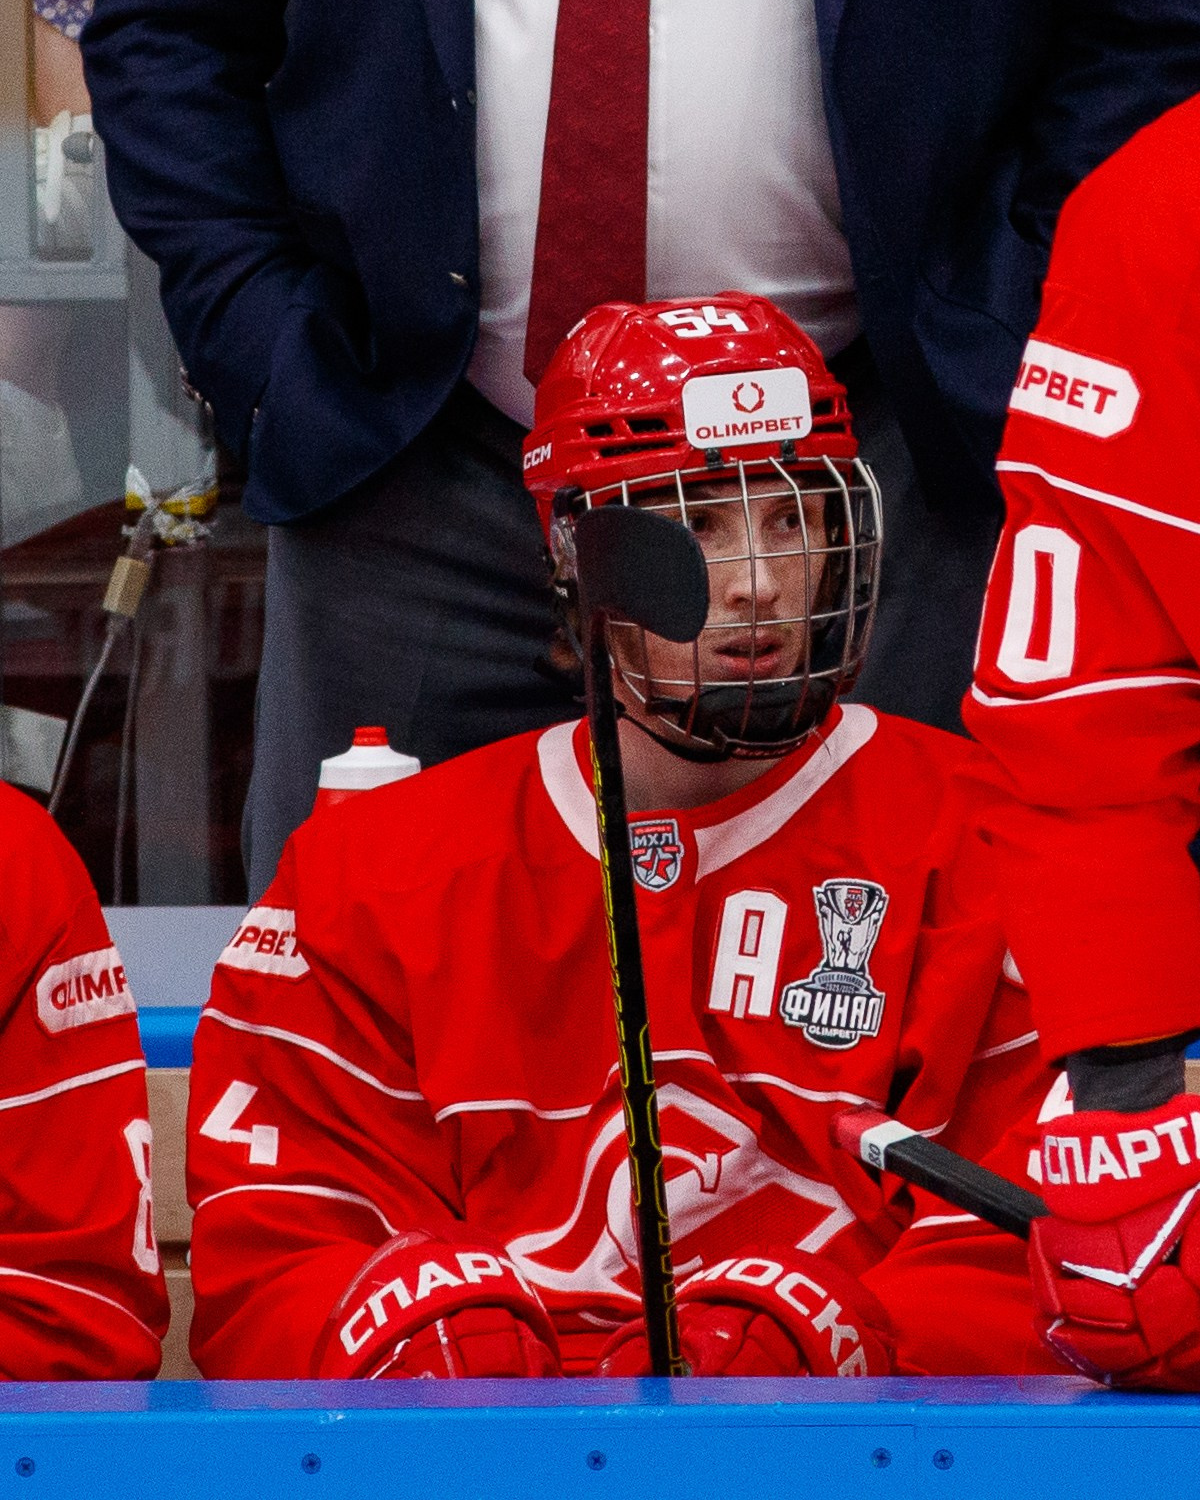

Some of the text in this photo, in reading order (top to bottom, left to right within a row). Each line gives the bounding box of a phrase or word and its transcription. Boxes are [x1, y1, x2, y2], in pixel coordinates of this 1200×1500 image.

[657, 305, 750, 338] 54
[695, 416, 804, 440] OLIMPBET
[523, 442, 552, 471] CCM
[996, 524, 1082, 684] 0
[634, 833, 673, 849] МХЛ
[708, 889, 788, 1017] A
[785, 987, 882, 1032] ФИНАЛ
[807, 1025, 858, 1041] OLIMPBET
[200, 1080, 279, 1166] 4
